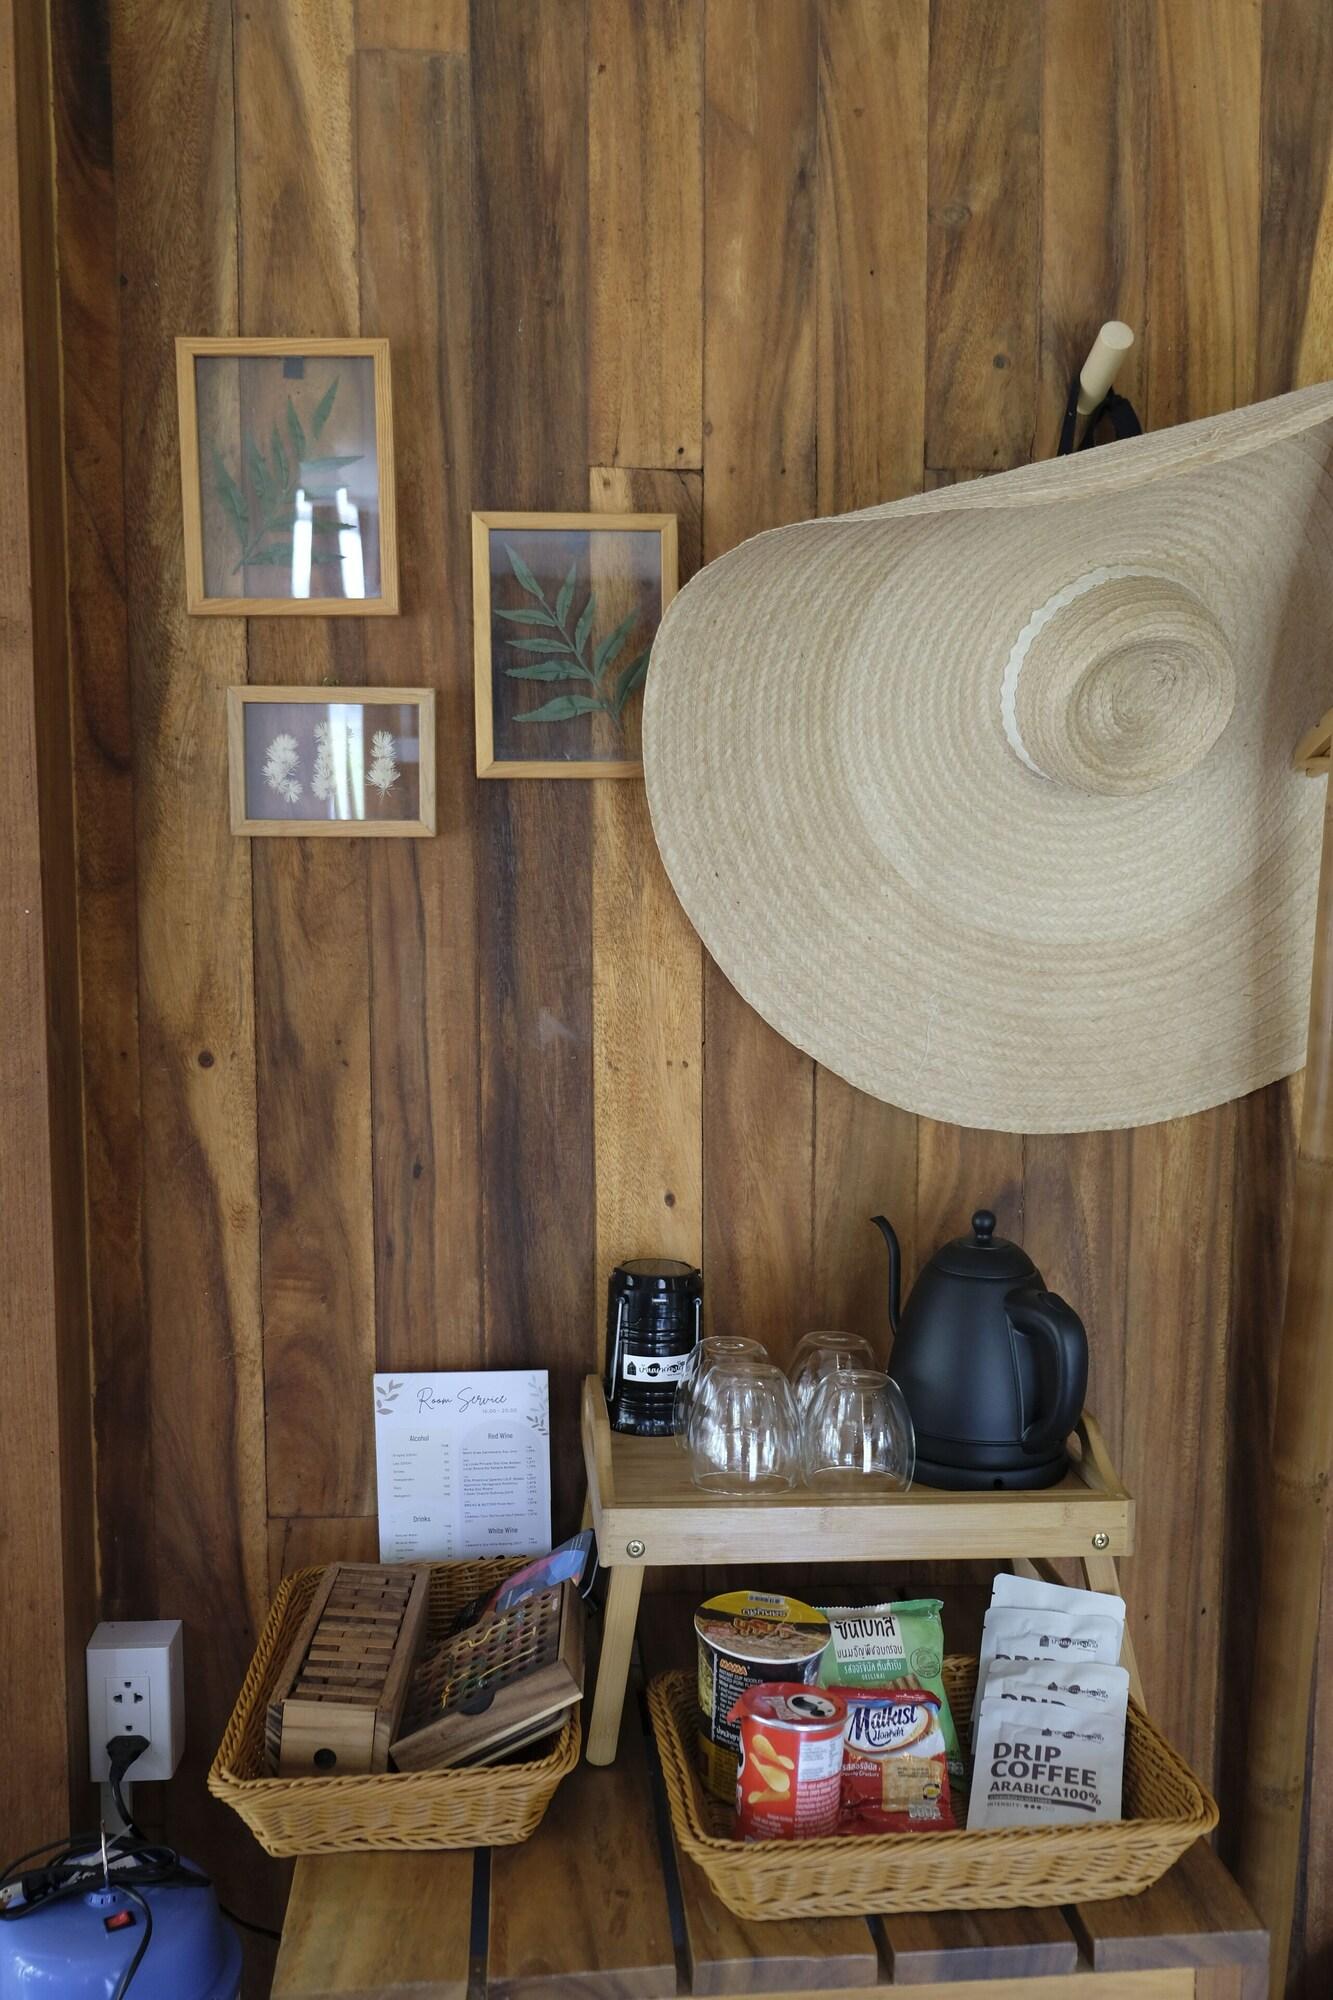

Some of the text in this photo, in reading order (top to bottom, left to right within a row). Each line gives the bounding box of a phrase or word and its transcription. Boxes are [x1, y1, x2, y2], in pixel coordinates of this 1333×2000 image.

[417, 1387, 507, 1413] Room Service
[409, 1434, 429, 1442] Alcohol
[993, 1743, 1061, 1762] DRIP
[991, 1760, 1096, 1789] COFFEE
[990, 1781, 1101, 1806] ARABICA100%
